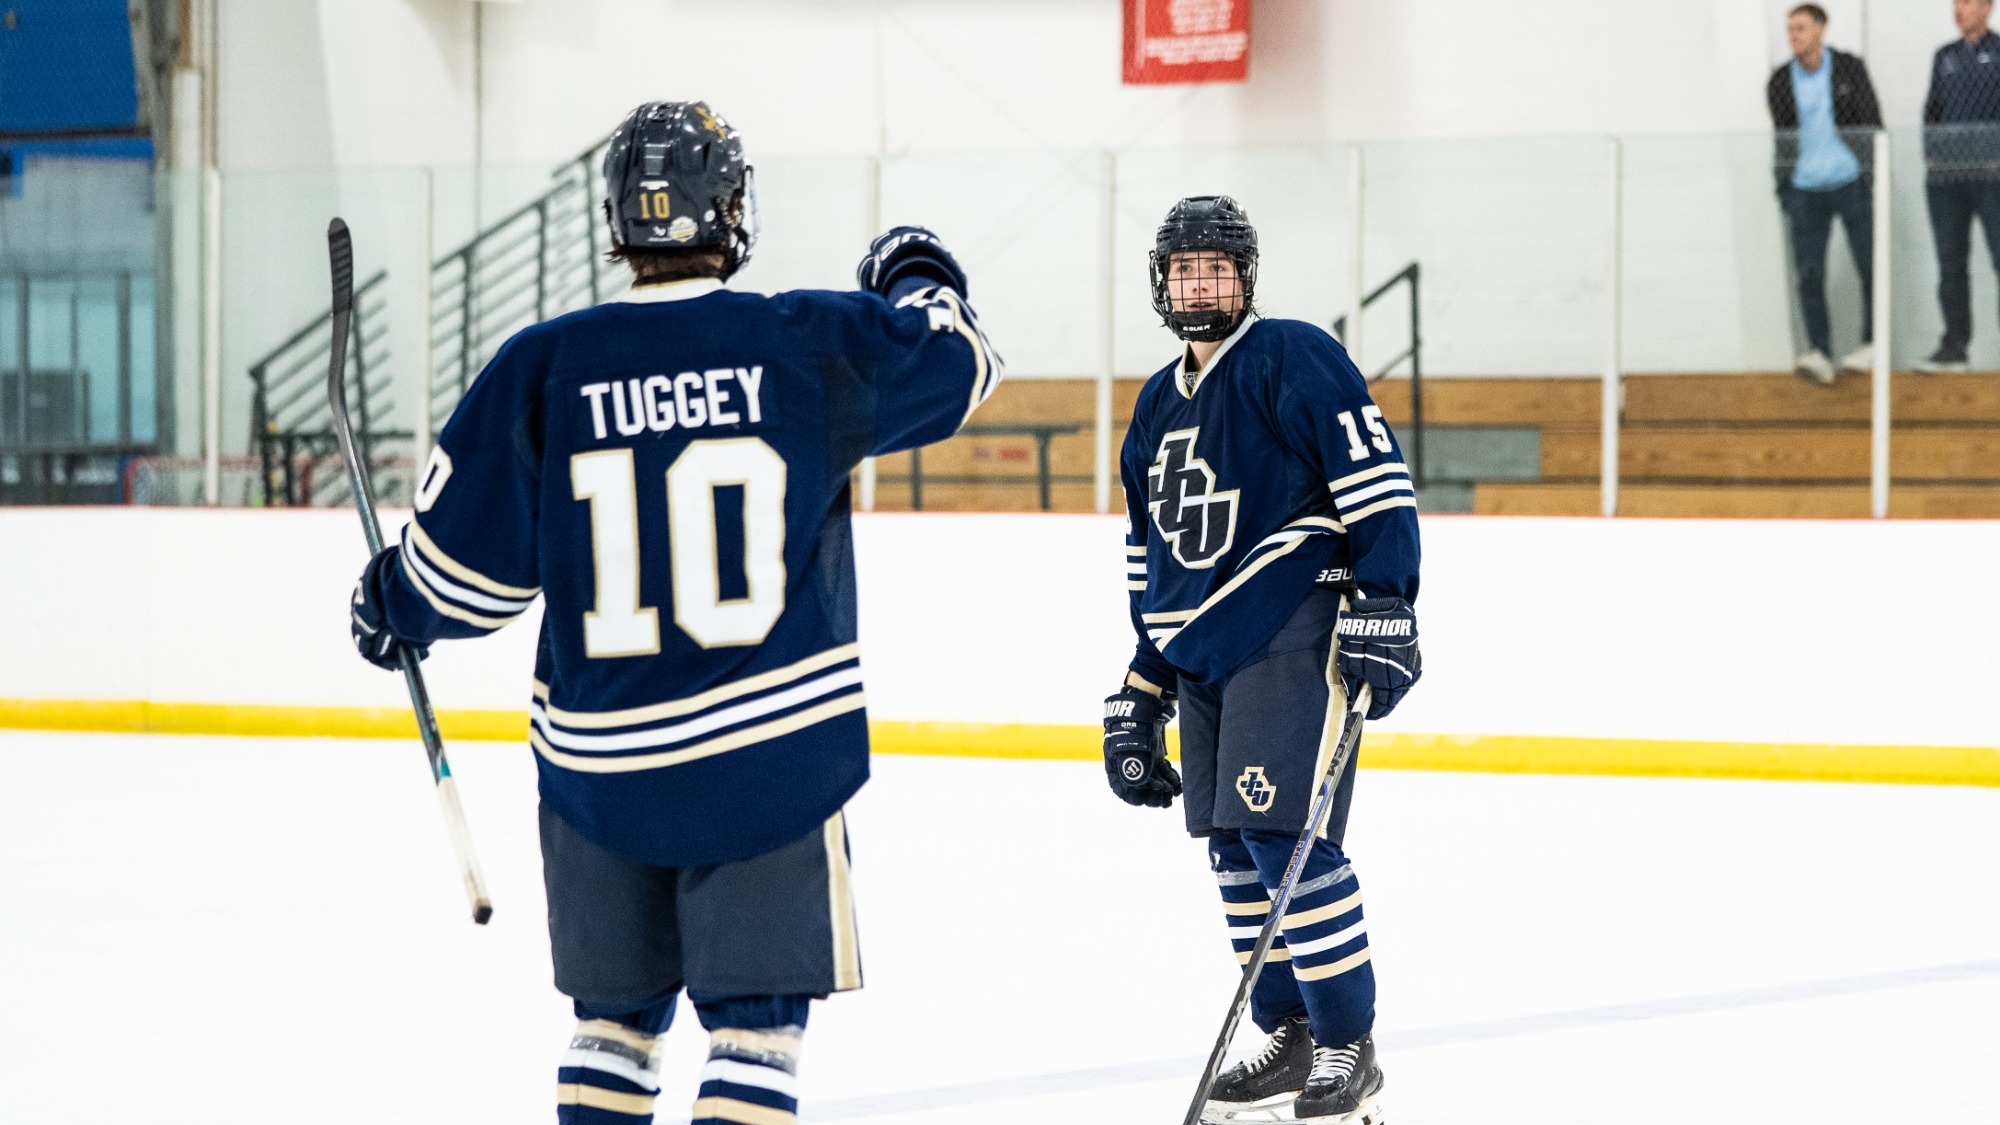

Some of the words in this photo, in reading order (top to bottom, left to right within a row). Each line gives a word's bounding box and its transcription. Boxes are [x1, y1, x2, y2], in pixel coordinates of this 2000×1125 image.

[639, 192, 671, 219] 10
[580, 366, 764, 439] TUGGEY
[1337, 404, 1393, 462] 15
[570, 436, 787, 659] 10
[1315, 567, 1356, 582] BAU
